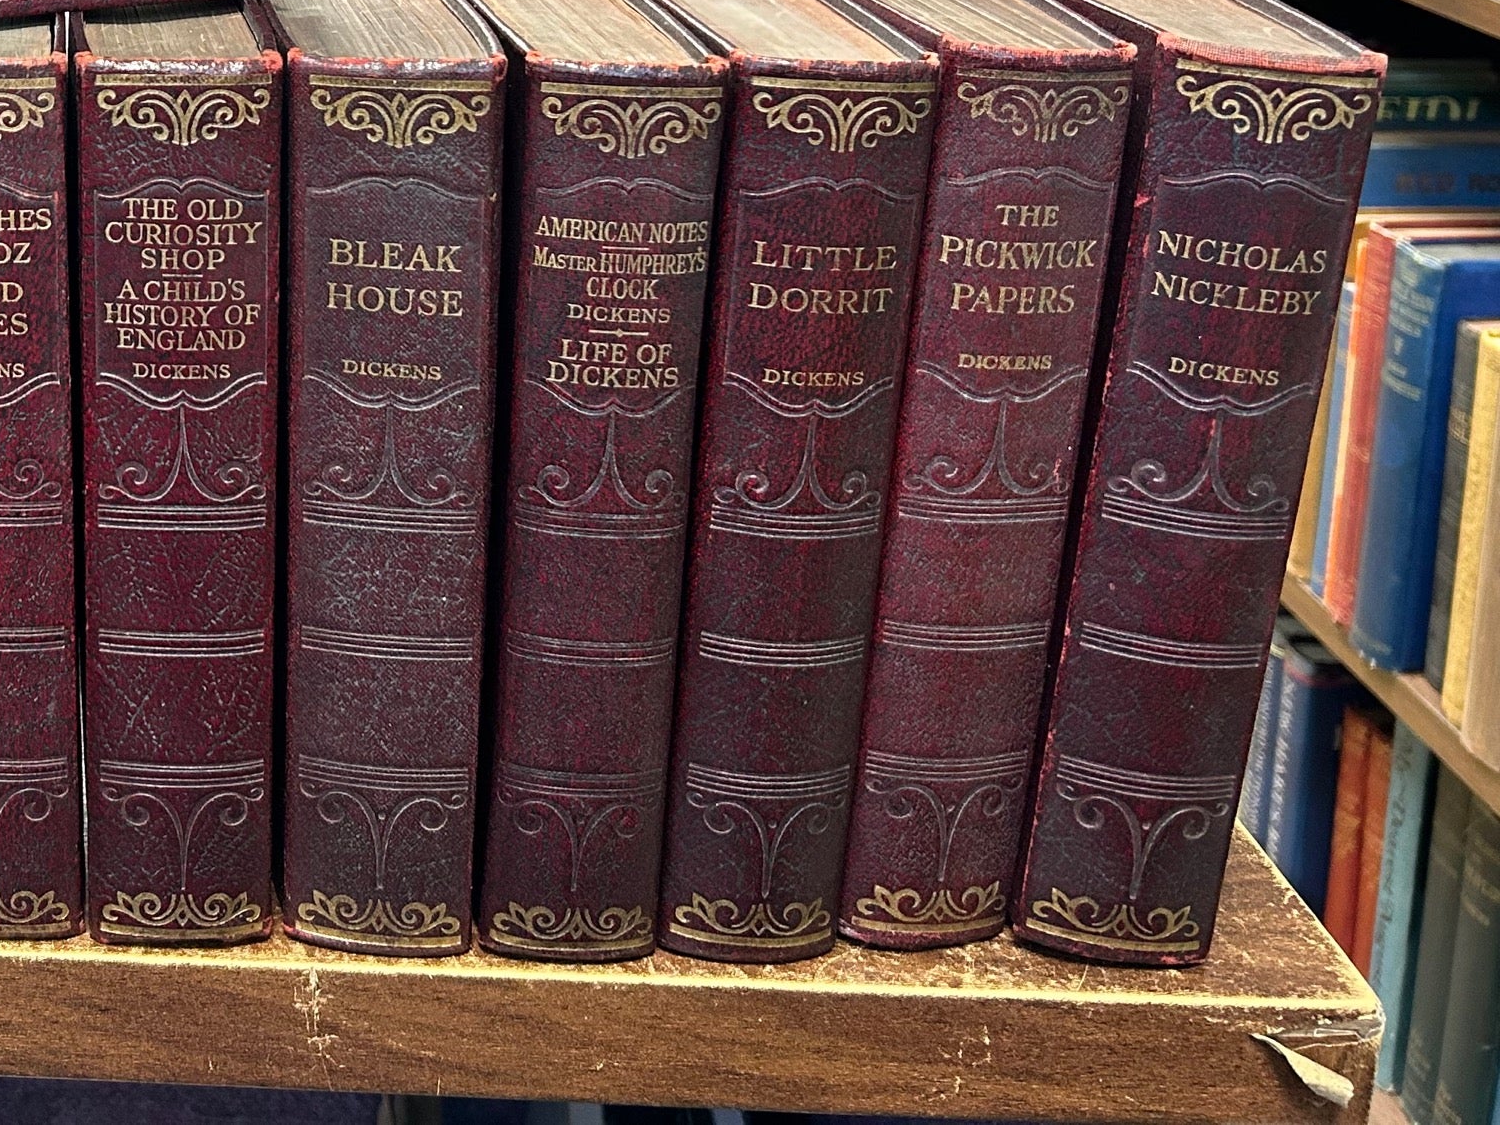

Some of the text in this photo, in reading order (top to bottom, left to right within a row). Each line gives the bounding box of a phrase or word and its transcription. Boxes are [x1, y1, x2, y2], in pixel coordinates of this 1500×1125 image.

[122, 198, 243, 220] THE OLD
[997, 204, 1059, 228] THE
[104, 221, 262, 246] CURIOSITY
[535, 215, 708, 243] AMERICAN NOTES
[141, 248, 225, 271] SHOP
[328, 238, 462, 273] BLEAK
[751, 240, 898, 272] LITTLE
[939, 234, 1098, 269] PICKWICK
[1157, 229, 1328, 275] NICHOLAS
[117, 279, 246, 302] A CHILD'S
[326, 281, 463, 317] HOUSE
[586, 276, 659, 301] CLOCK
[747, 281, 894, 315] DORRIT
[950, 282, 1076, 315] PAPERS
[1150, 270, 1321, 316] NICKLEBY
[104, 302, 261, 328] HISTORY OF
[567, 303, 671, 325] DICKENS
[117, 328, 246, 351] ENGLAND
[558, 338, 673, 365] LIFE OF
[132, 361, 231, 379] DICKENS
[342, 358, 442, 381] DICKENS
[546, 360, 679, 389] DICKENS
[958, 352, 1052, 371] DICKENS
[1168, 356, 1280, 386] DICKENS
[762, 368, 865, 387] DICKENS
